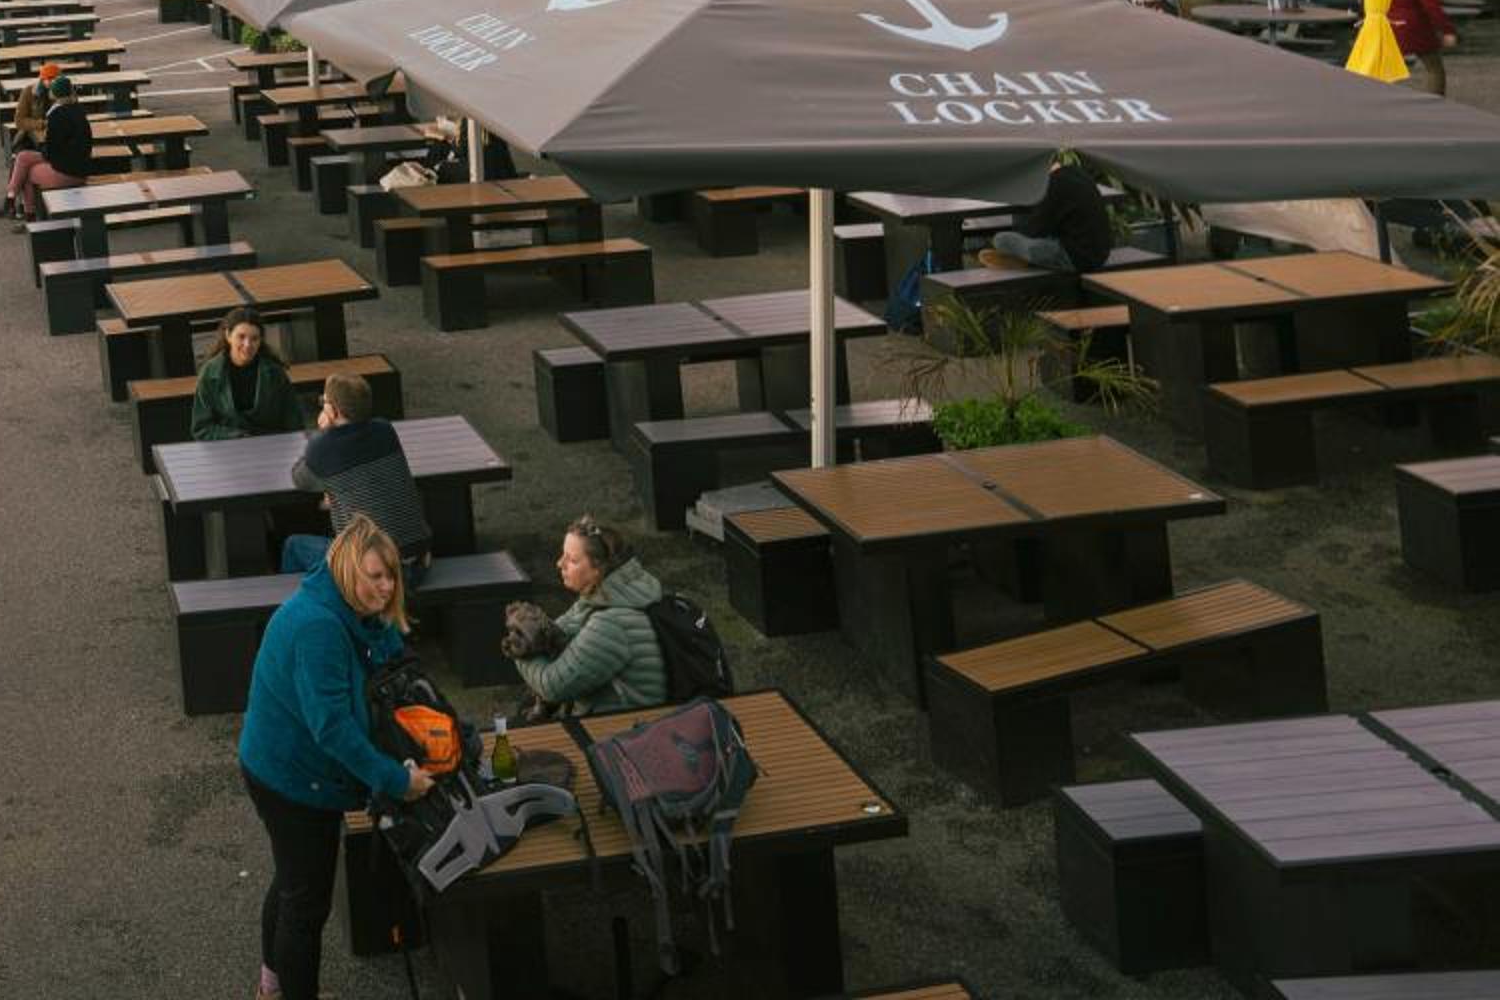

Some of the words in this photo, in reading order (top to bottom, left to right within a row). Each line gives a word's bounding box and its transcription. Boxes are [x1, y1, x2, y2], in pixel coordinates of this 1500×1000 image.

[407, 23, 499, 72] LOCKER
[454, 12, 537, 51] CHAIN
[889, 70, 1105, 98] CHAIN
[887, 99, 1172, 125] LOCKER
